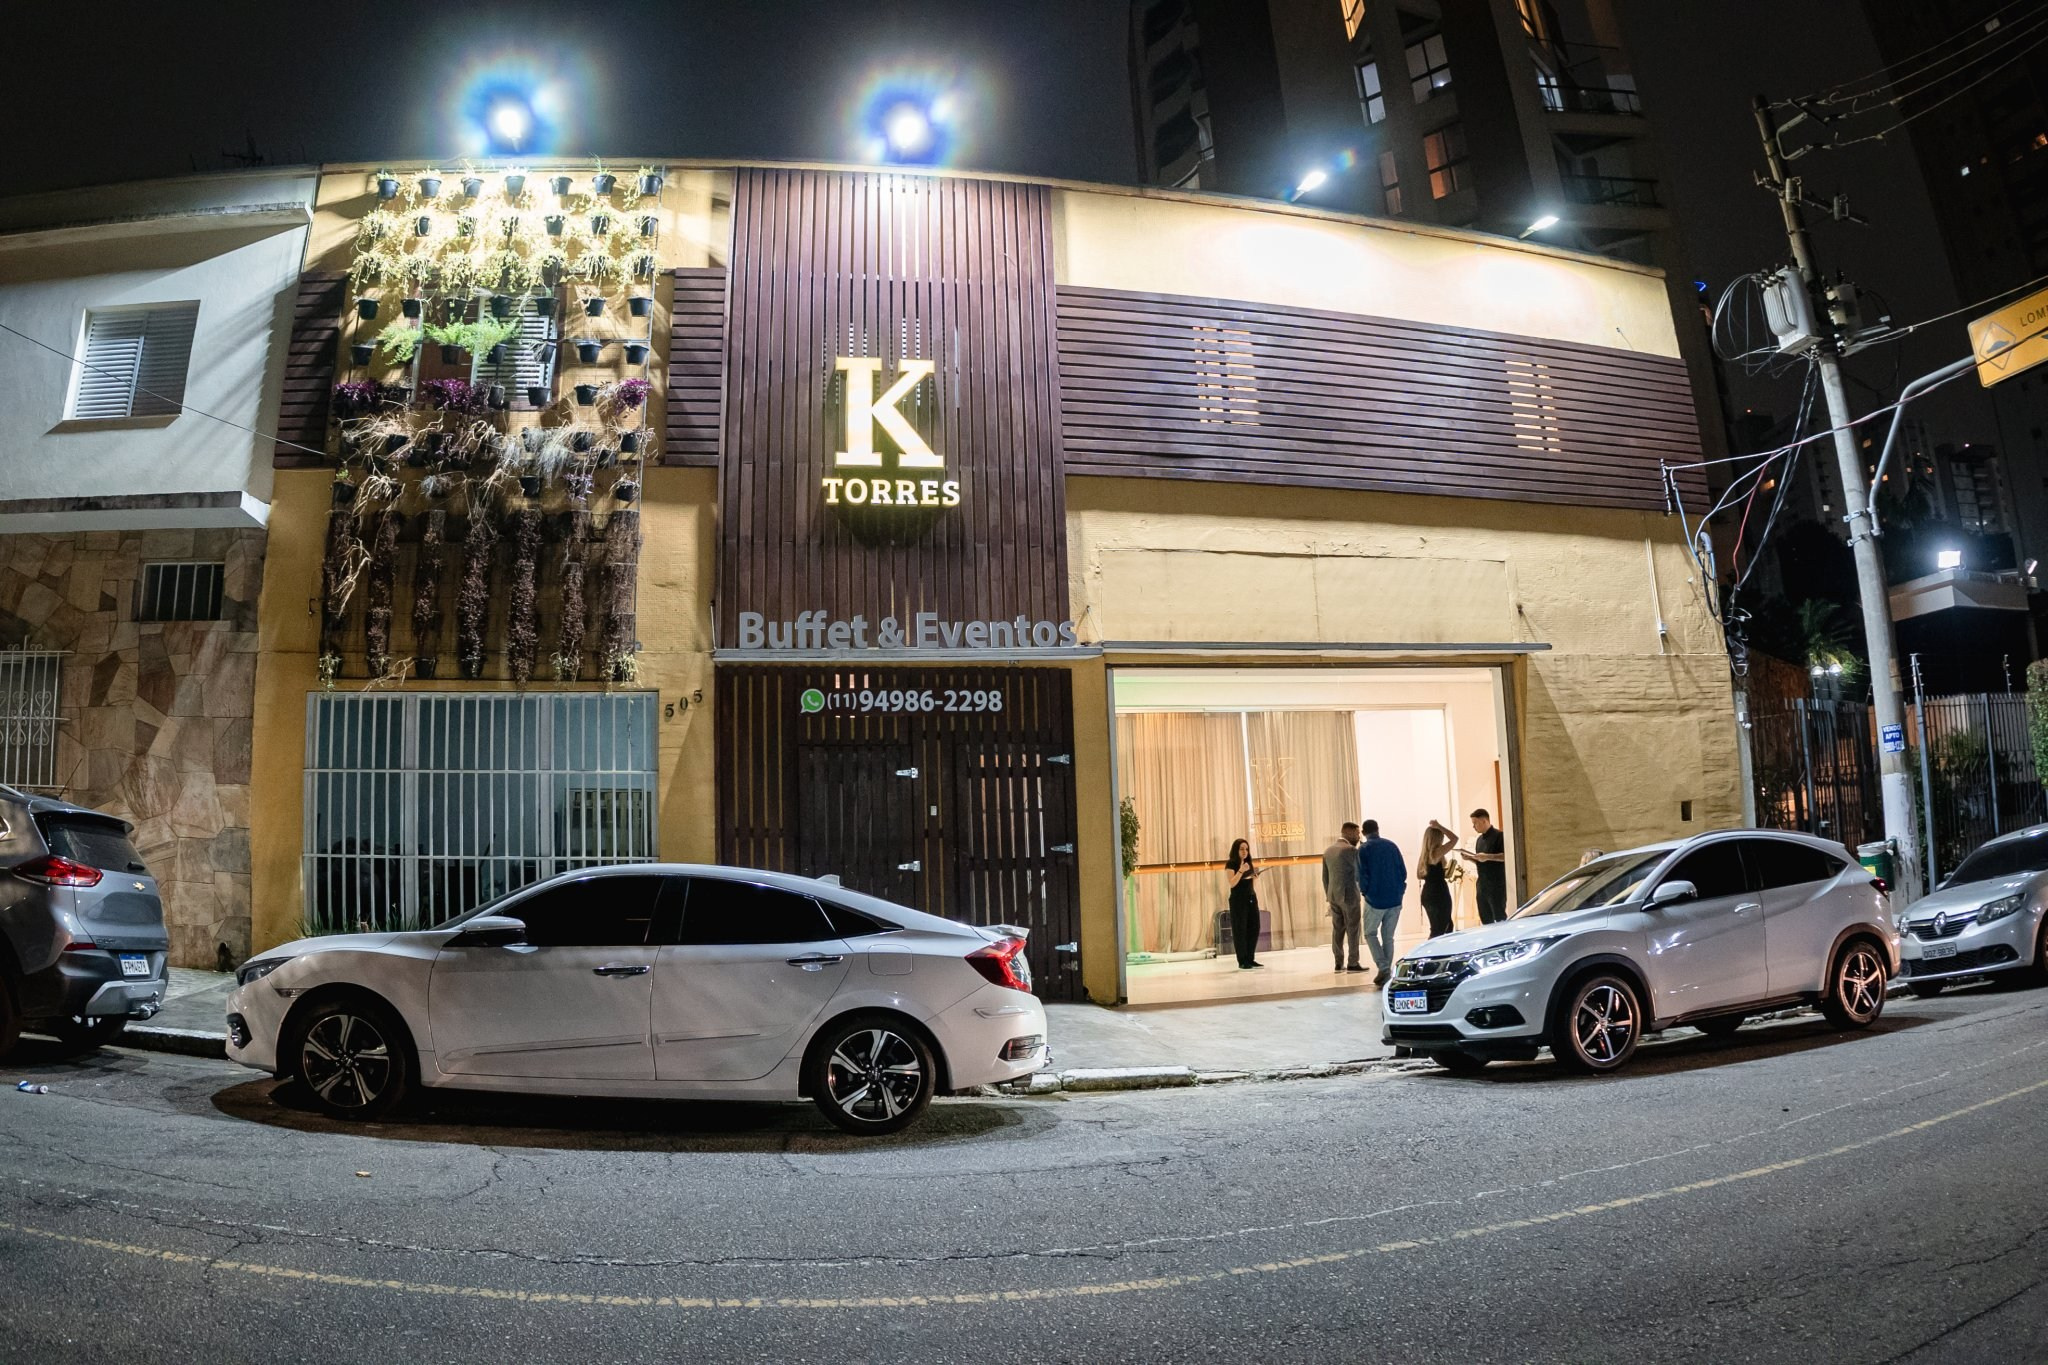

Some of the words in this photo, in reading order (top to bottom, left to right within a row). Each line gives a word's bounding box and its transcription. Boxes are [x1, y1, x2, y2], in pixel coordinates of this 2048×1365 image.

[2020, 305, 2048, 327] LOM
[835, 357, 944, 468] K
[822, 478, 961, 506] TORRES
[739, 611, 868, 649] Buffet
[878, 617, 905, 648] &
[916, 612, 1077, 648] Eventos
[665, 688, 703, 718] 505
[827, 692, 857, 709] (11)
[859, 690, 1003, 712] 94986-2298
